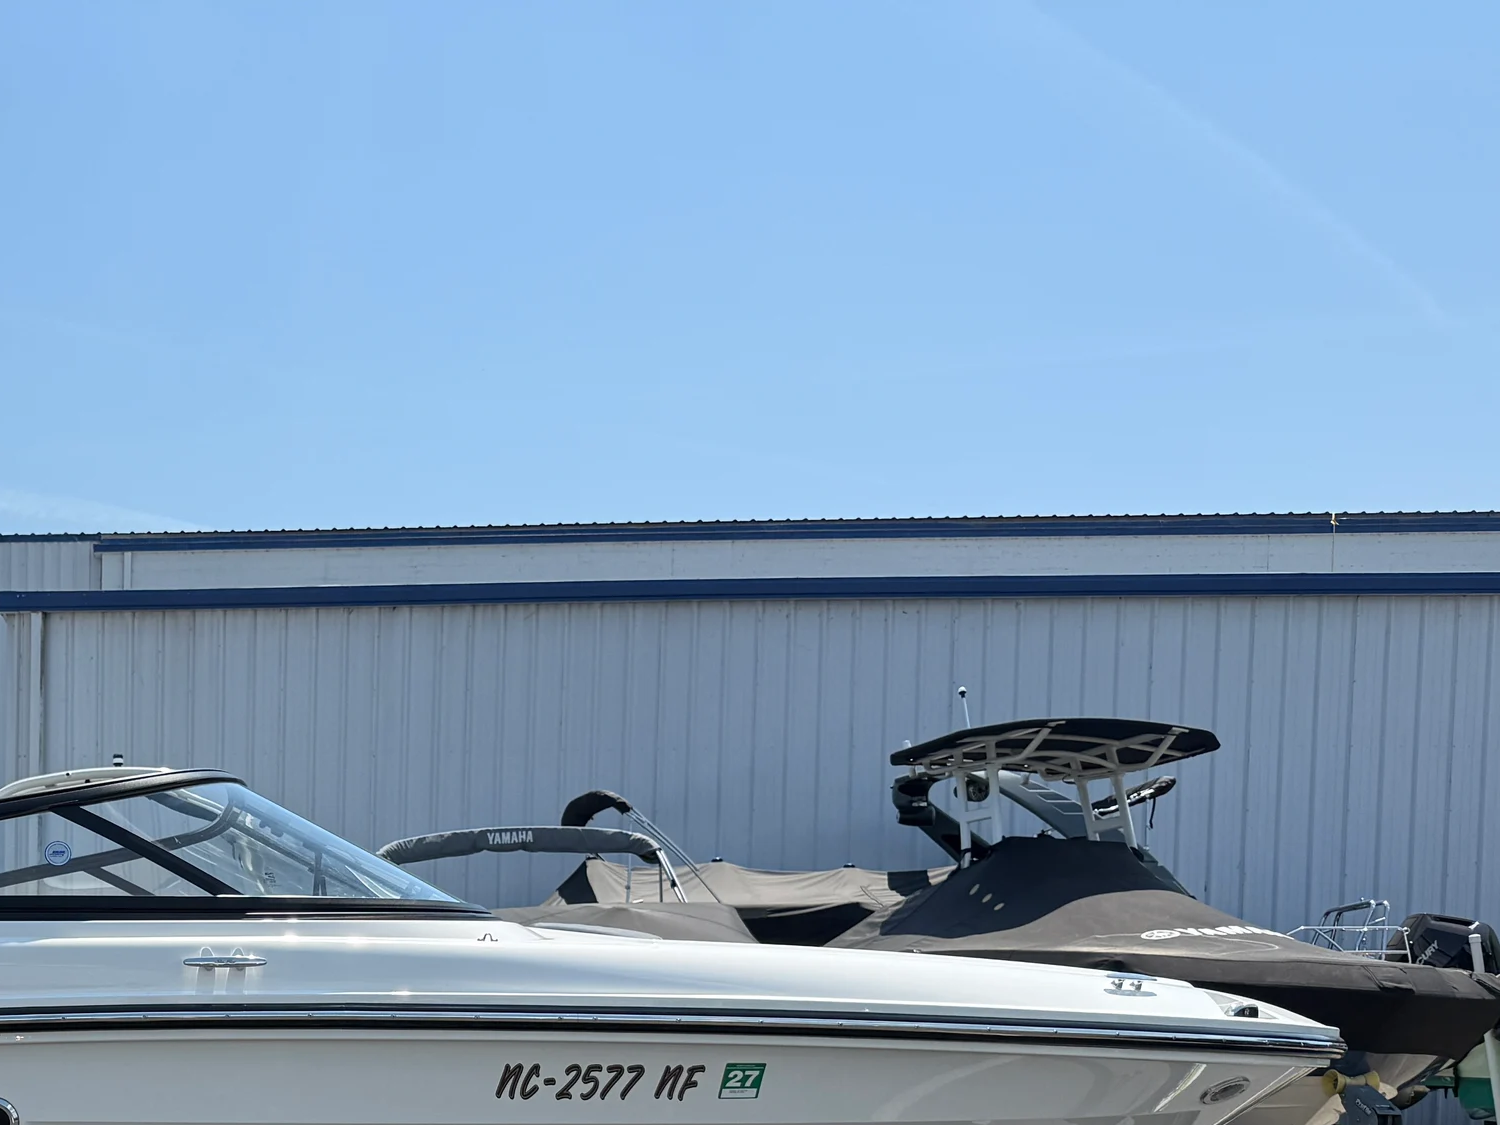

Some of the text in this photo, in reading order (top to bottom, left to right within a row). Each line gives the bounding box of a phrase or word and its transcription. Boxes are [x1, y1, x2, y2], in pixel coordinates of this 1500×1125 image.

[486, 830, 534, 845] YAMAHA
[1173, 925, 1295, 940] YAMA
[1416, 939, 1439, 965] CURY
[495, 1063, 706, 1101] NC-2577 NF
[724, 1070, 760, 1087] 27
